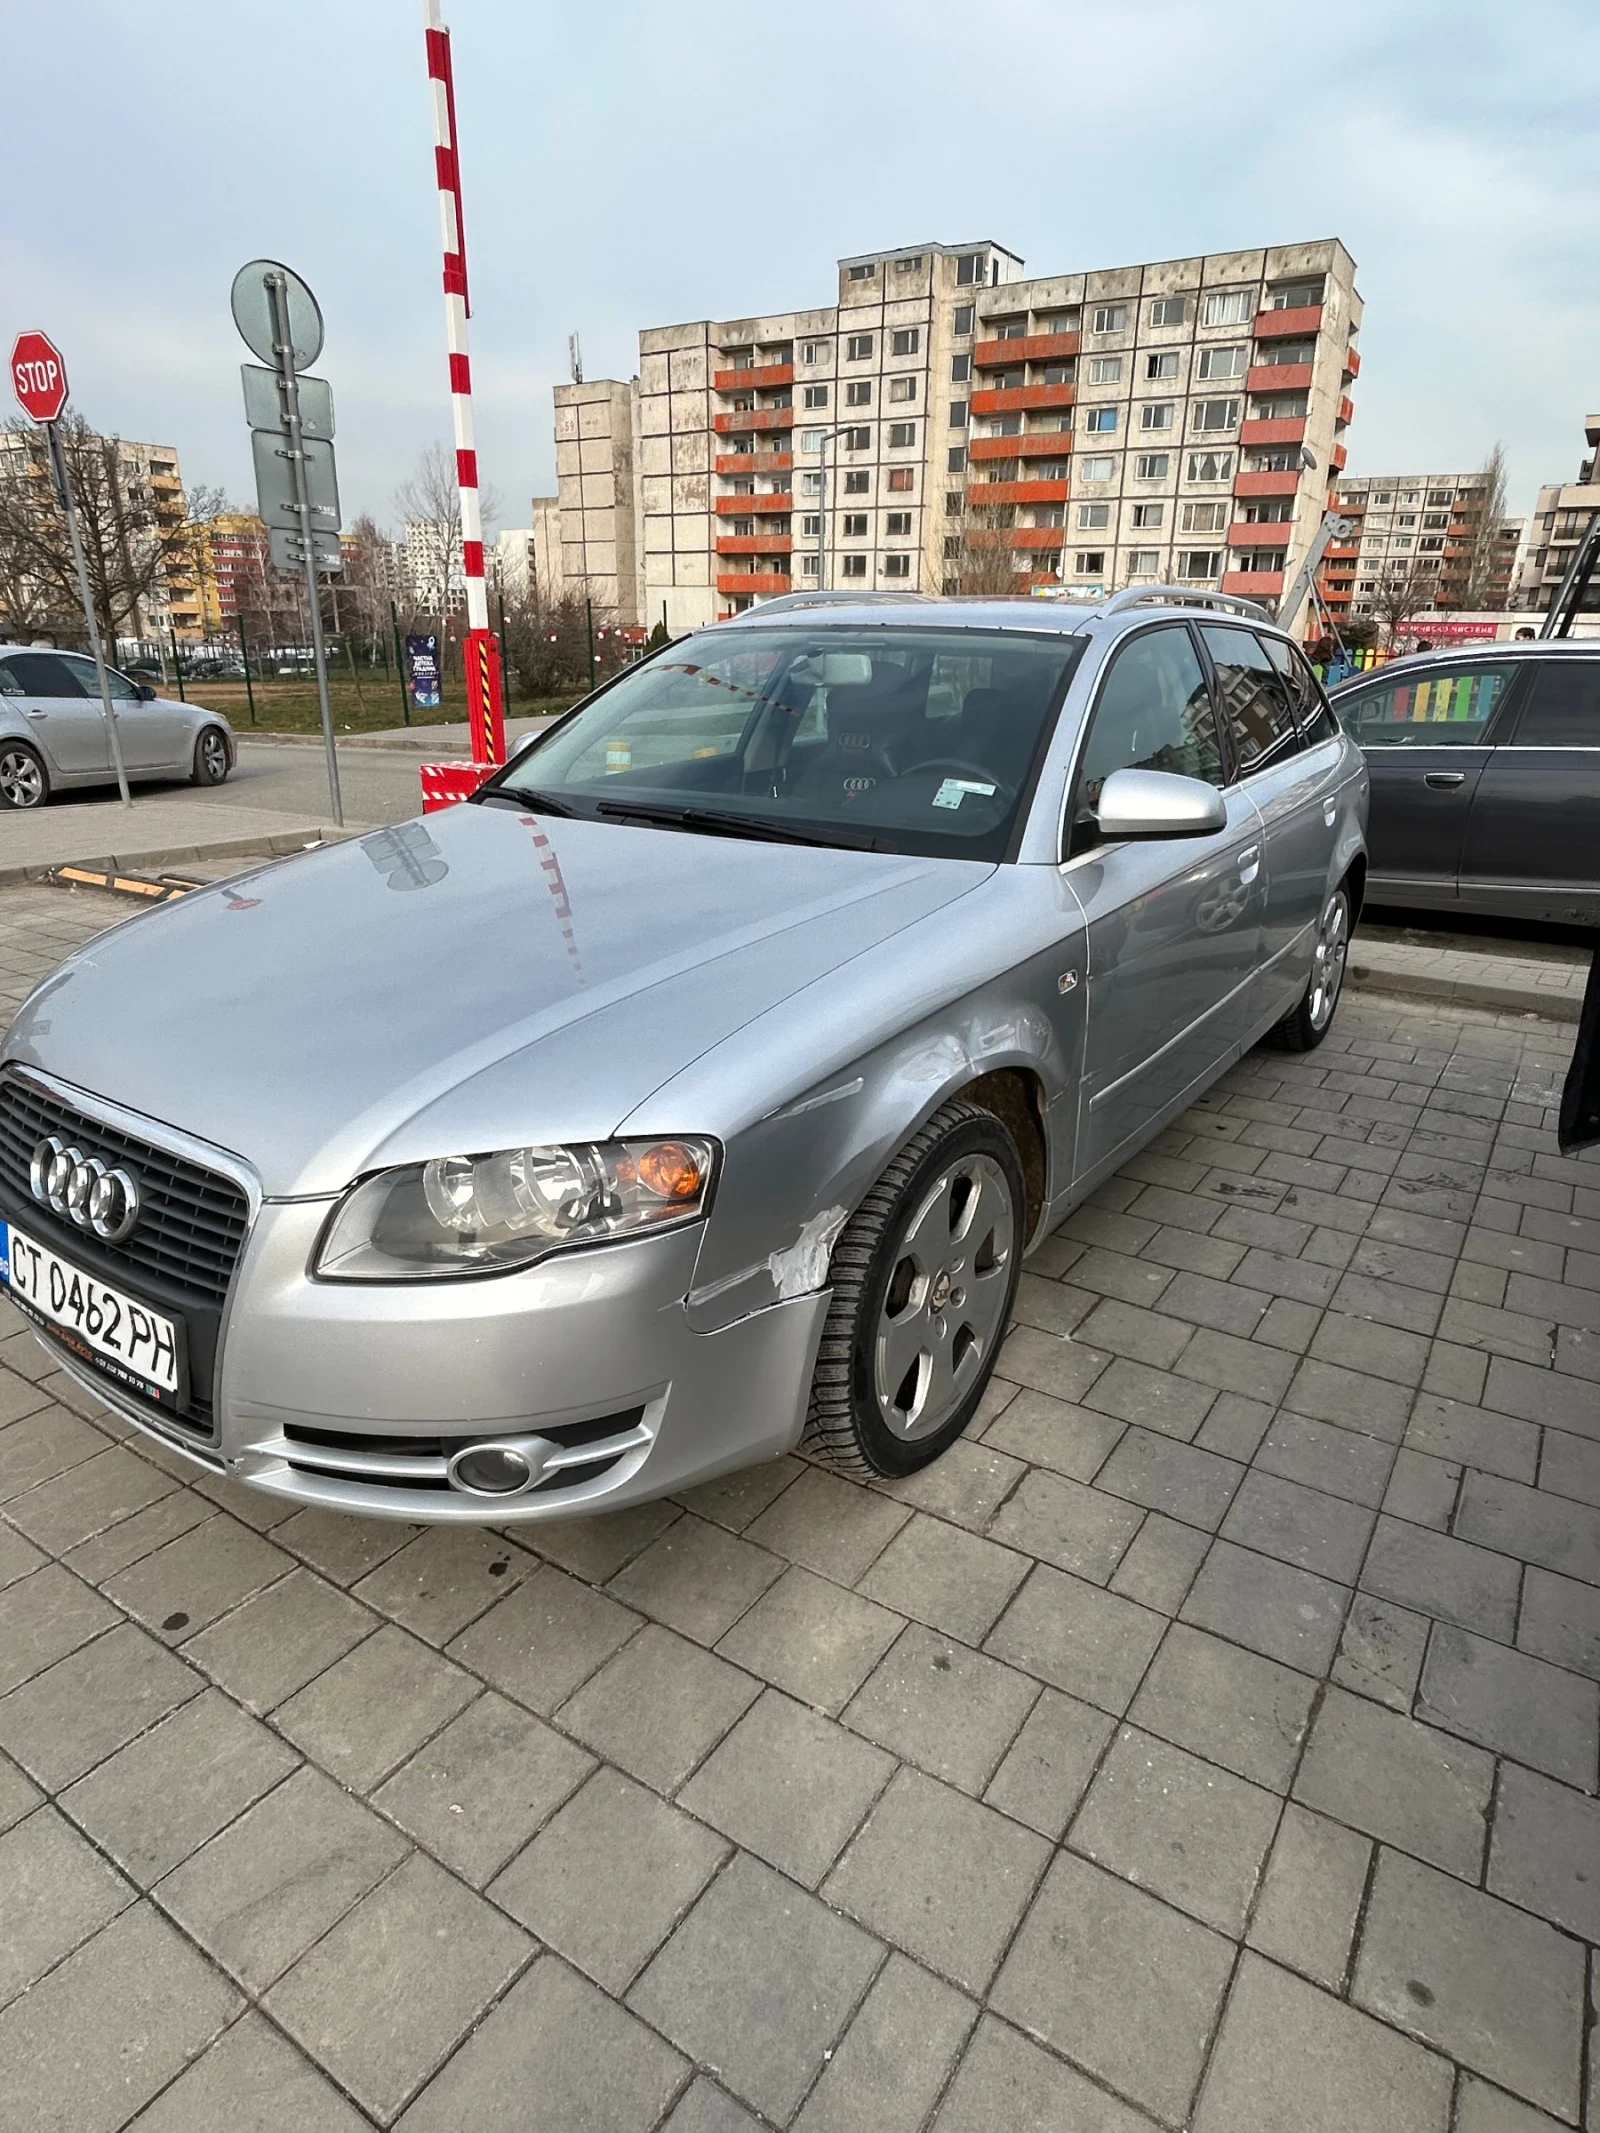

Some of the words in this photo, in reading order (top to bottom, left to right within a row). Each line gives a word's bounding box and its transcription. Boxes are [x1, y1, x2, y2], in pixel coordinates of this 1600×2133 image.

[16, 360, 57, 394] STOP
[1451, 626, 1493, 634] ЧИСТЕНЕ
[12, 1235, 42, 1299] CT
[49, 1261, 122, 1351] 0462
[127, 1303, 175, 1382] PH
